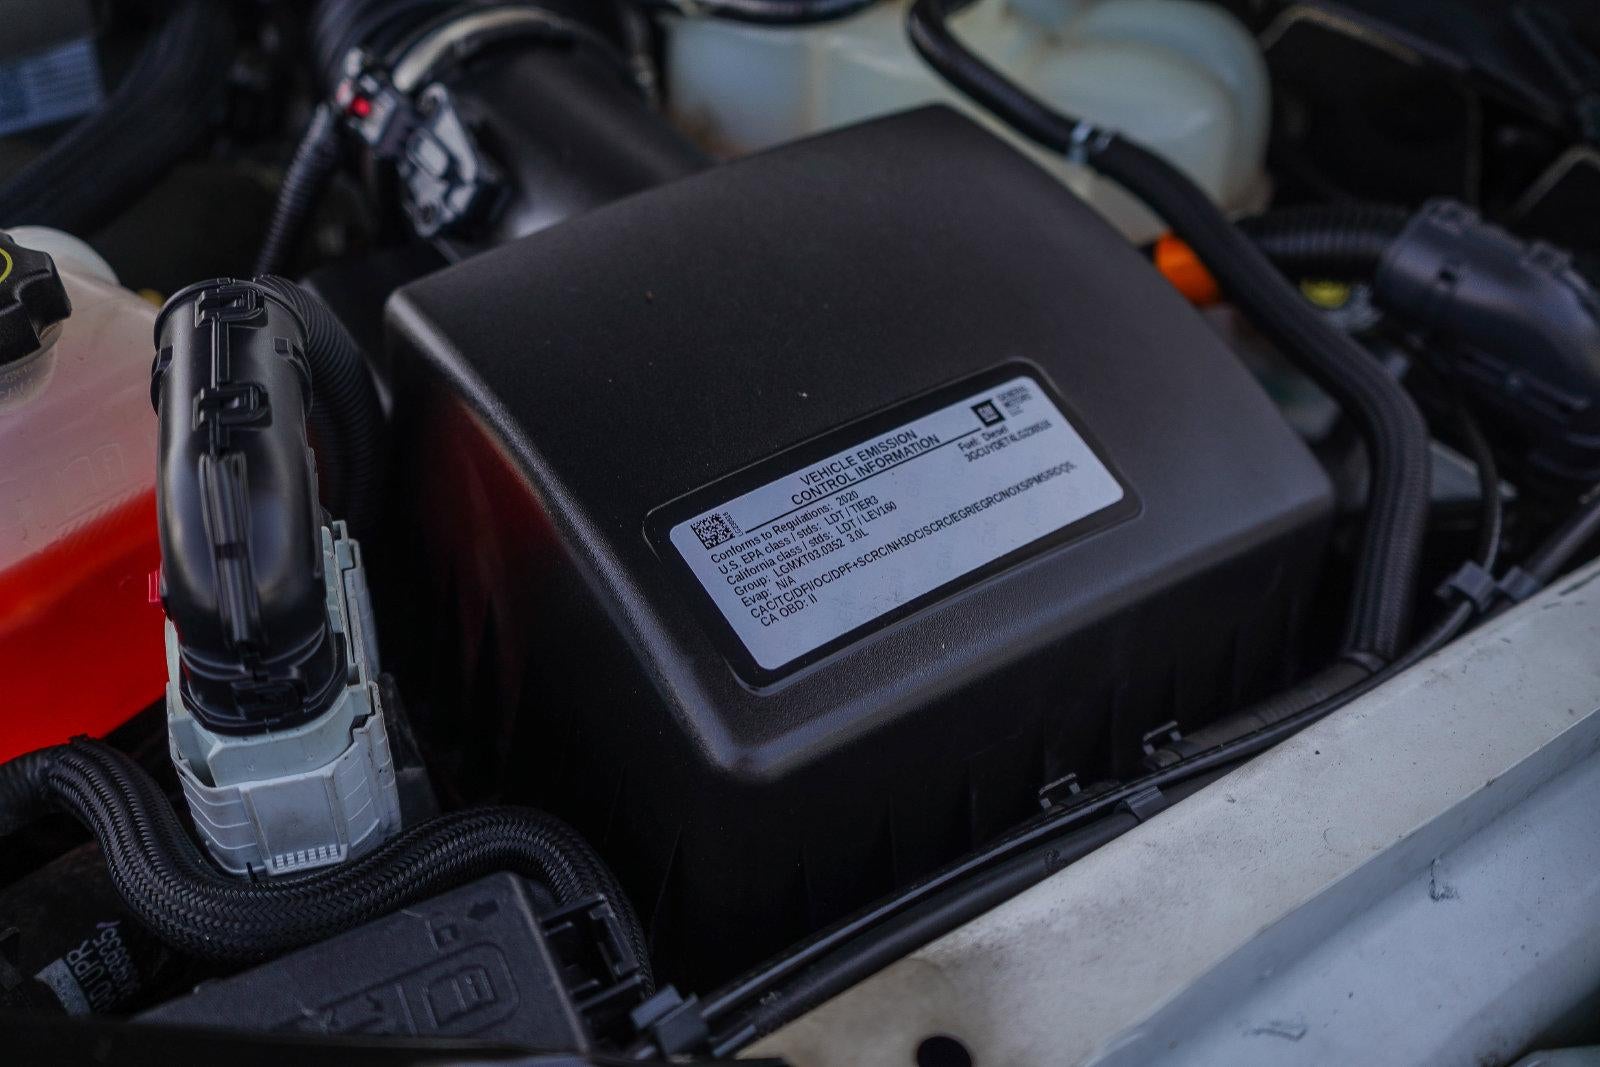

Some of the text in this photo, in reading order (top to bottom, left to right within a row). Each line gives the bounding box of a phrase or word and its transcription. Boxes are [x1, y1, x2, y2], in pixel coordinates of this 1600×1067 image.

[791, 434, 940, 507] CONTROL INFORMATION
[800, 428, 918, 487] VEHICLE EMISSION
[710, 490, 860, 564] Conforms to Regulations: 2020
[717, 560, 742, 575] U.S.
[741, 550, 765, 564] EPA
[765, 536, 791, 554] class
[799, 522, 822, 539] stds:
[824, 509, 846, 526] LDT
[851, 495, 879, 513] TIER3
[726, 558, 776, 586] California
[776, 546, 803, 562] class
[809, 531, 833, 546] stds:
[836, 519, 858, 535] LDT
[865, 501, 897, 524] LEV160
[733, 529, 869, 597] Group: LGMXT03.0352 3.0L
[740, 575, 797, 608] Evap: N/A
[760, 613, 780, 627] CA
[779, 600, 809, 618] OBD:
[67, 940, 105, 987] UPR
